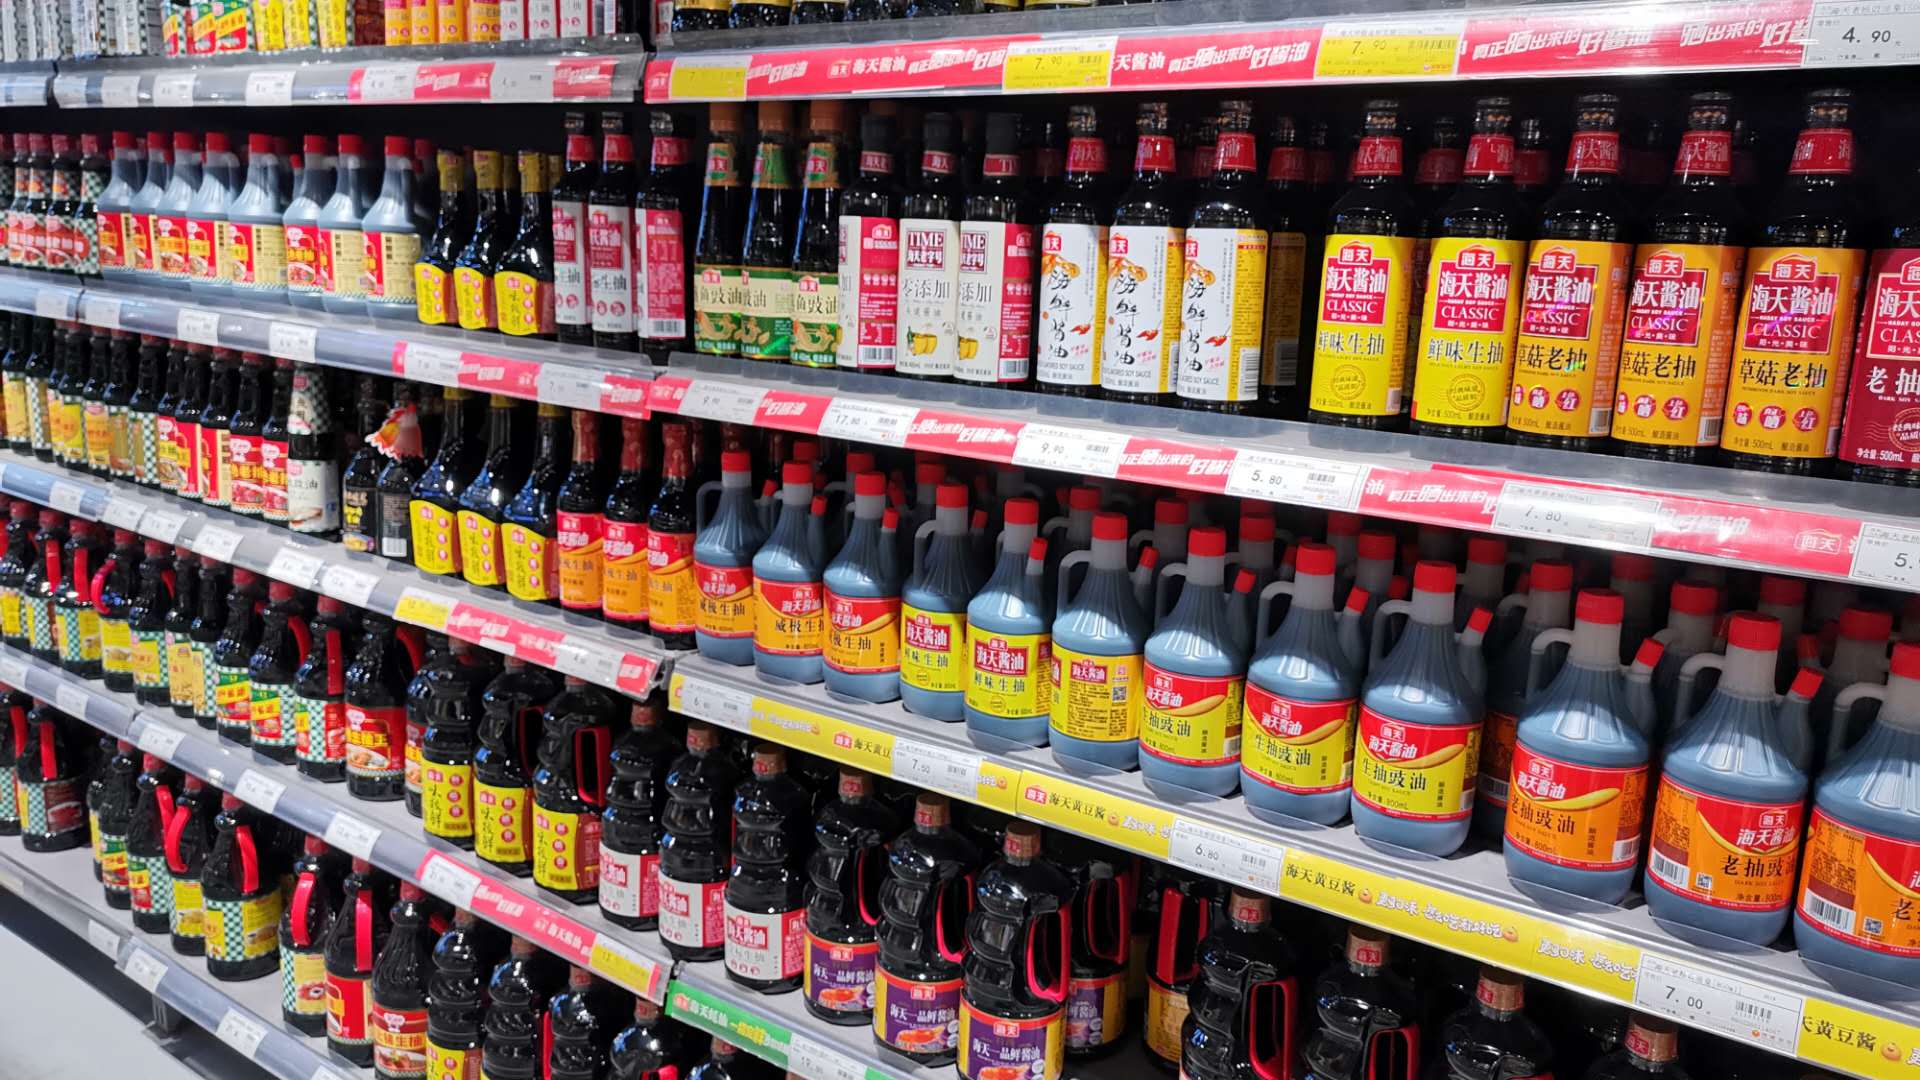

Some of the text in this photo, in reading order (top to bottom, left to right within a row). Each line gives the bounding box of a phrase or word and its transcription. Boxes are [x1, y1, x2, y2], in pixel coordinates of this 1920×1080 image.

[1842, 28, 1891, 46] 4.90
[1112, 51, 1165, 71] 天酱油
[907, 231, 943, 247] TIME
[1342, 249, 1369, 263] 海天
[1461, 252, 1491, 266] 海天
[1542, 254, 1572, 269] 海天
[1649, 258, 1679, 274] 海天
[1326, 266, 1386, 294] 海天酱油
[1775, 263, 1811, 279] 海天
[1907, 266, 1920, 281] 海
[1440, 271, 1508, 300] 海天酱油
[1527, 274, 1592, 304] 海天酱油
[1631, 279, 1701, 309] 海天酱油
[1326, 299, 1377, 314] CLASSIC
[1752, 284, 1834, 316] 海天酱油
[1878, 287, 1920, 319] 海天
[1441, 305, 1500, 321] CLASSIC
[1525, 310, 1581, 326] CLASSIC
[1631, 315, 1689, 332] CLASSIC
[1752, 322, 1821, 340] CLASSIC
[1318, 330, 1385, 356] 鲜味生抽
[1880, 327, 1920, 344] CLAS
[1427, 337, 1504, 364] 鲜味生抽
[1620, 349, 1696, 379] 草菇老抽
[1740, 358, 1828, 388] 草菇老抽
[1866, 366, 1920, 396] 老抽
[1251, 469, 1282, 487] 5.80
[1366, 479, 1384, 495] 油
[1802, 535, 1838, 552] 海天
[1894, 553, 1920, 570] 5.
[703, 581, 737, 595] 海天酱油
[782, 600, 822, 613] 海天酱油
[906, 624, 948, 646] 海天酱油
[977, 647, 1025, 670] 海天酱油
[975, 671, 1025, 693] 鲜味生抽
[1147, 687, 1183, 707] 海天酱油
[1261, 713, 1303, 736] 海天酱油
[1383, 727, 1403, 739] 海天
[1255, 734, 1312, 767] 生抽豉油
[1369, 736, 1418, 759] 海天酱油
[1362, 758, 1427, 791] 生抽豉油
[1531, 763, 1551, 776] 海天
[1518, 771, 1566, 799] 海天酱油
[1026, 788, 1047, 803] 海天
[1049, 793, 1105, 820] 海天黄豆酱
[1511, 796, 1576, 835] 老抽豉油
[1763, 814, 1785, 826] 海天
[1736, 827, 1796, 847] 海天酱油
[1721, 855, 1795, 878] 老抽豉油
[1286, 863, 1354, 897] 海天黄豆酱
[1890, 898, 1920, 922] 老
[1664, 985, 1703, 1010] 7.00
[890, 1003, 956, 1023] 海天一品鲜酱油
[995, 1024, 1019, 1037] 海天
[1802, 1015, 1876, 1053] 天黄豆酱
[973, 1037, 1041, 1062] 海天一品鲜酱油
